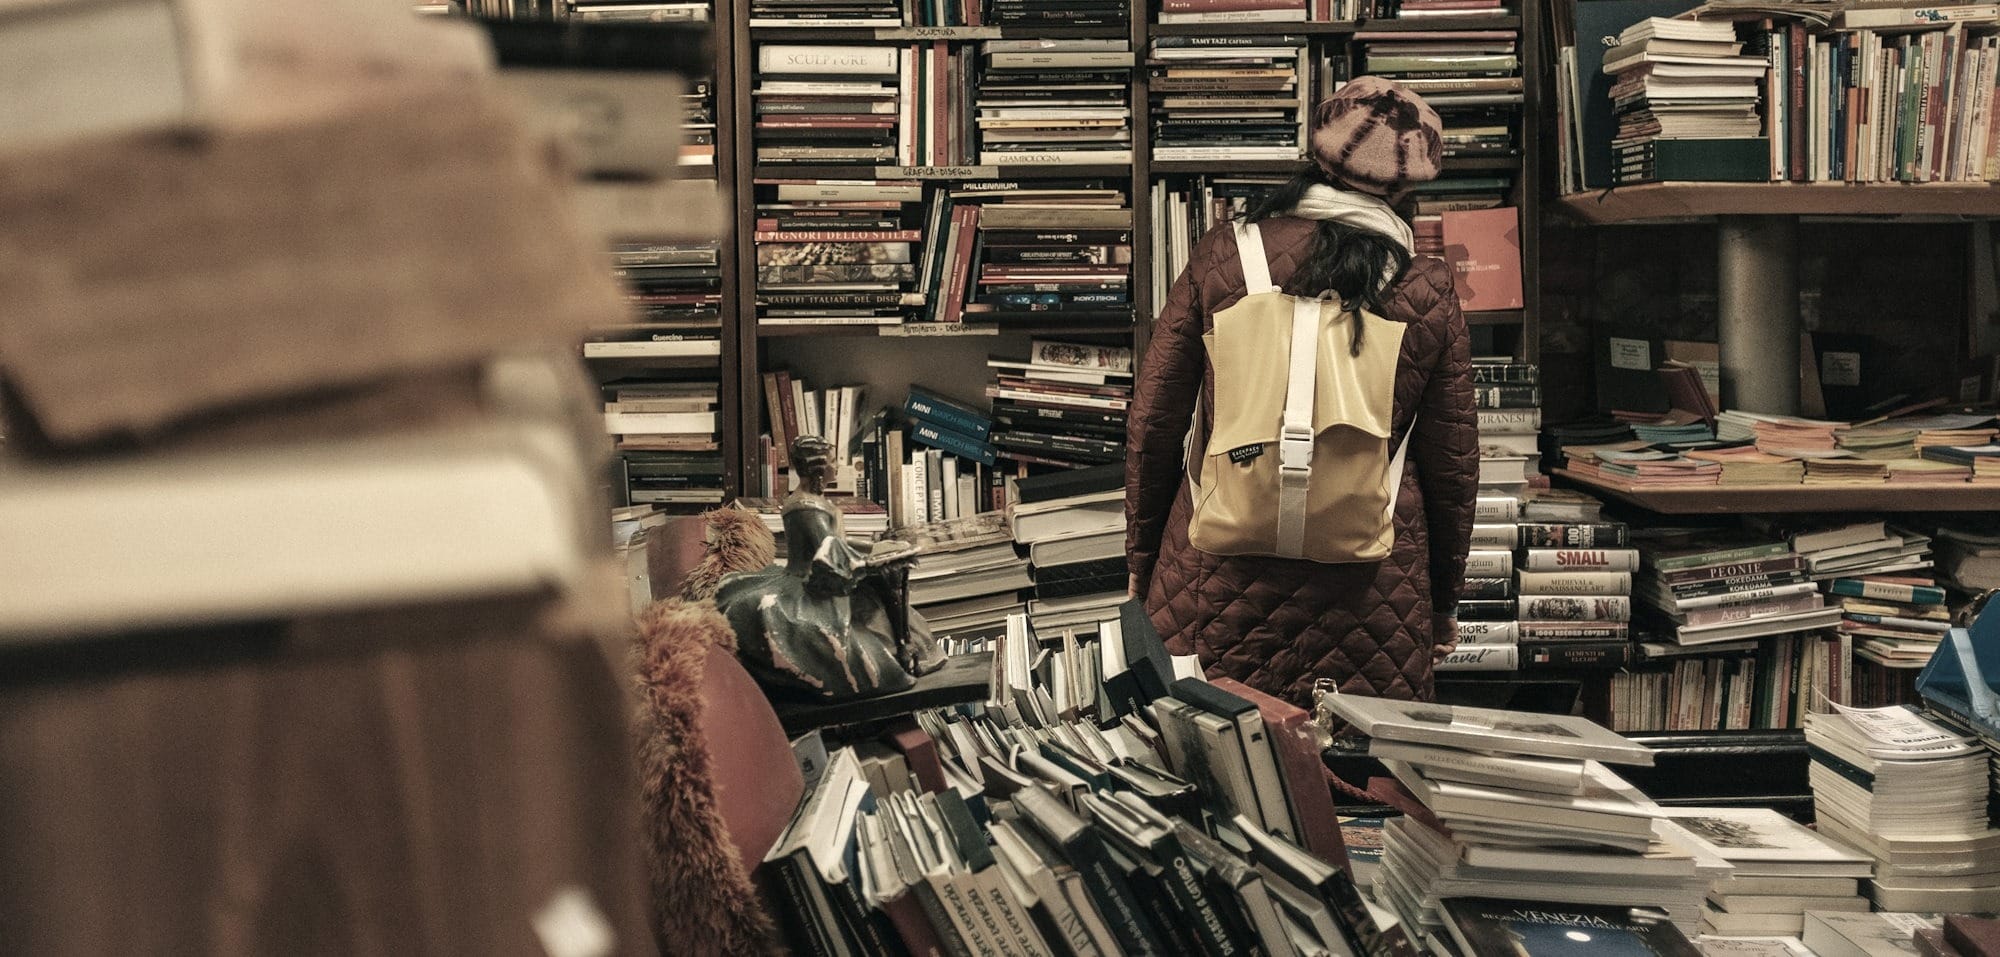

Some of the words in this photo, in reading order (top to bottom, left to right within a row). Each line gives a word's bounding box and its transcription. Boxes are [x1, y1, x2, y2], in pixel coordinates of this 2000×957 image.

[787, 54, 868, 65] SCULPTURE
[999, 155, 1061, 163] GIAMBOLOGNA
[767, 231, 821, 239] SIGNORI
[826, 231, 867, 239] DELLO
[872, 230, 909, 239] STILE
[767, 296, 804, 304] MAESTRI
[912, 402, 931, 415] MINI
[1478, 413, 1526, 424] PIRANESI
[919, 427, 938, 440] MINI
[933, 491, 942, 521] BMW
[1556, 551, 1609, 566] SMALL
[1710, 562, 1763, 578] PEONIE
[1725, 574, 1769, 585] KOKEDAMA
[1729, 581, 1772, 593] KOKEDAMA
[1721, 609, 1745, 621] Arte
[942, 882, 971, 931] venezia
[966, 887, 994, 936] venezia
[989, 887, 1019, 936] venezia
[1513, 909, 1608, 926] VENEZIA
